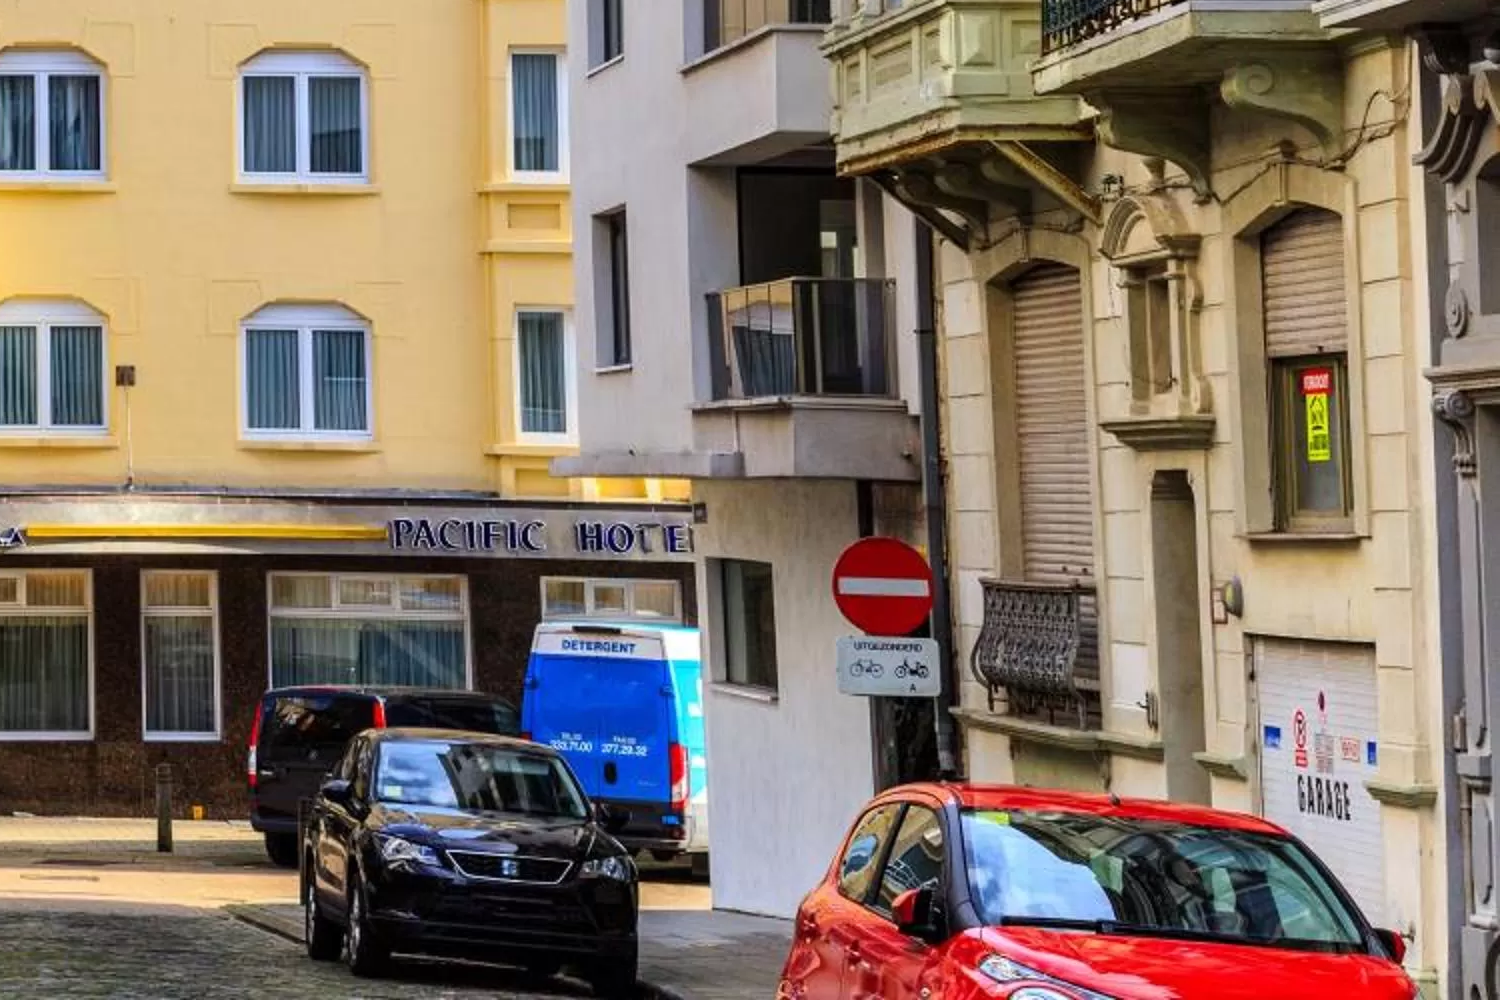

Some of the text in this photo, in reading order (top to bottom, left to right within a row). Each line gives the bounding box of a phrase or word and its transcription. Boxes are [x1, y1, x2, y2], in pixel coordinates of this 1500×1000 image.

[388, 516, 548, 551] PACIFIC
[561, 639, 637, 654] DETERGENT
[853, 641, 923, 652] UITGEZONDERD
[909, 683, 917, 693] A
[1297, 774, 1351, 821] GARAGE
